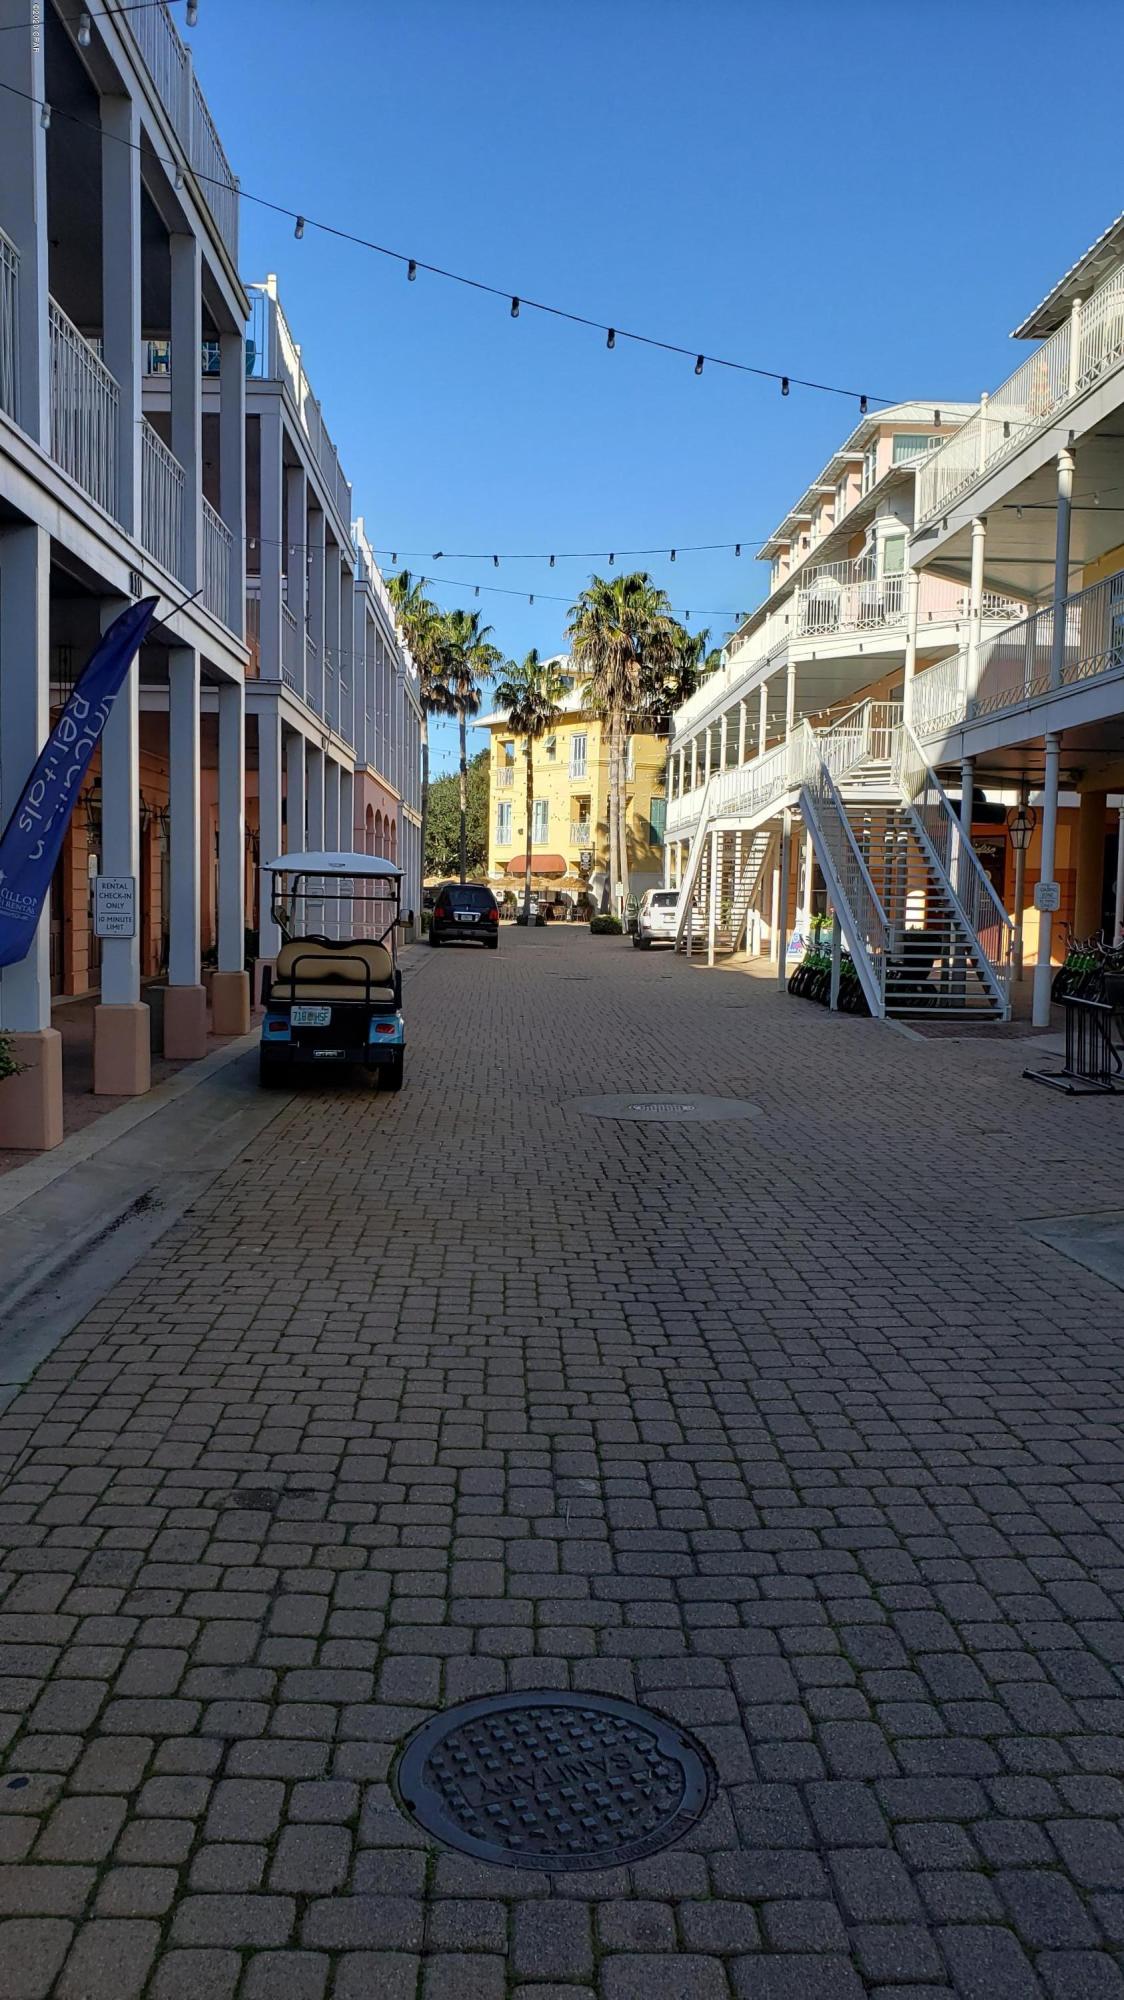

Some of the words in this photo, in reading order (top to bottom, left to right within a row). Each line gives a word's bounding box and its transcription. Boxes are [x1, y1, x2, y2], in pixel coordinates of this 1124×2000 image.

[19, 691, 90, 833] Rentals
[102, 882, 128, 890] RENTAL
[106, 923, 124, 931] LIMIT
[478, 1751, 633, 1801] SANITARY
